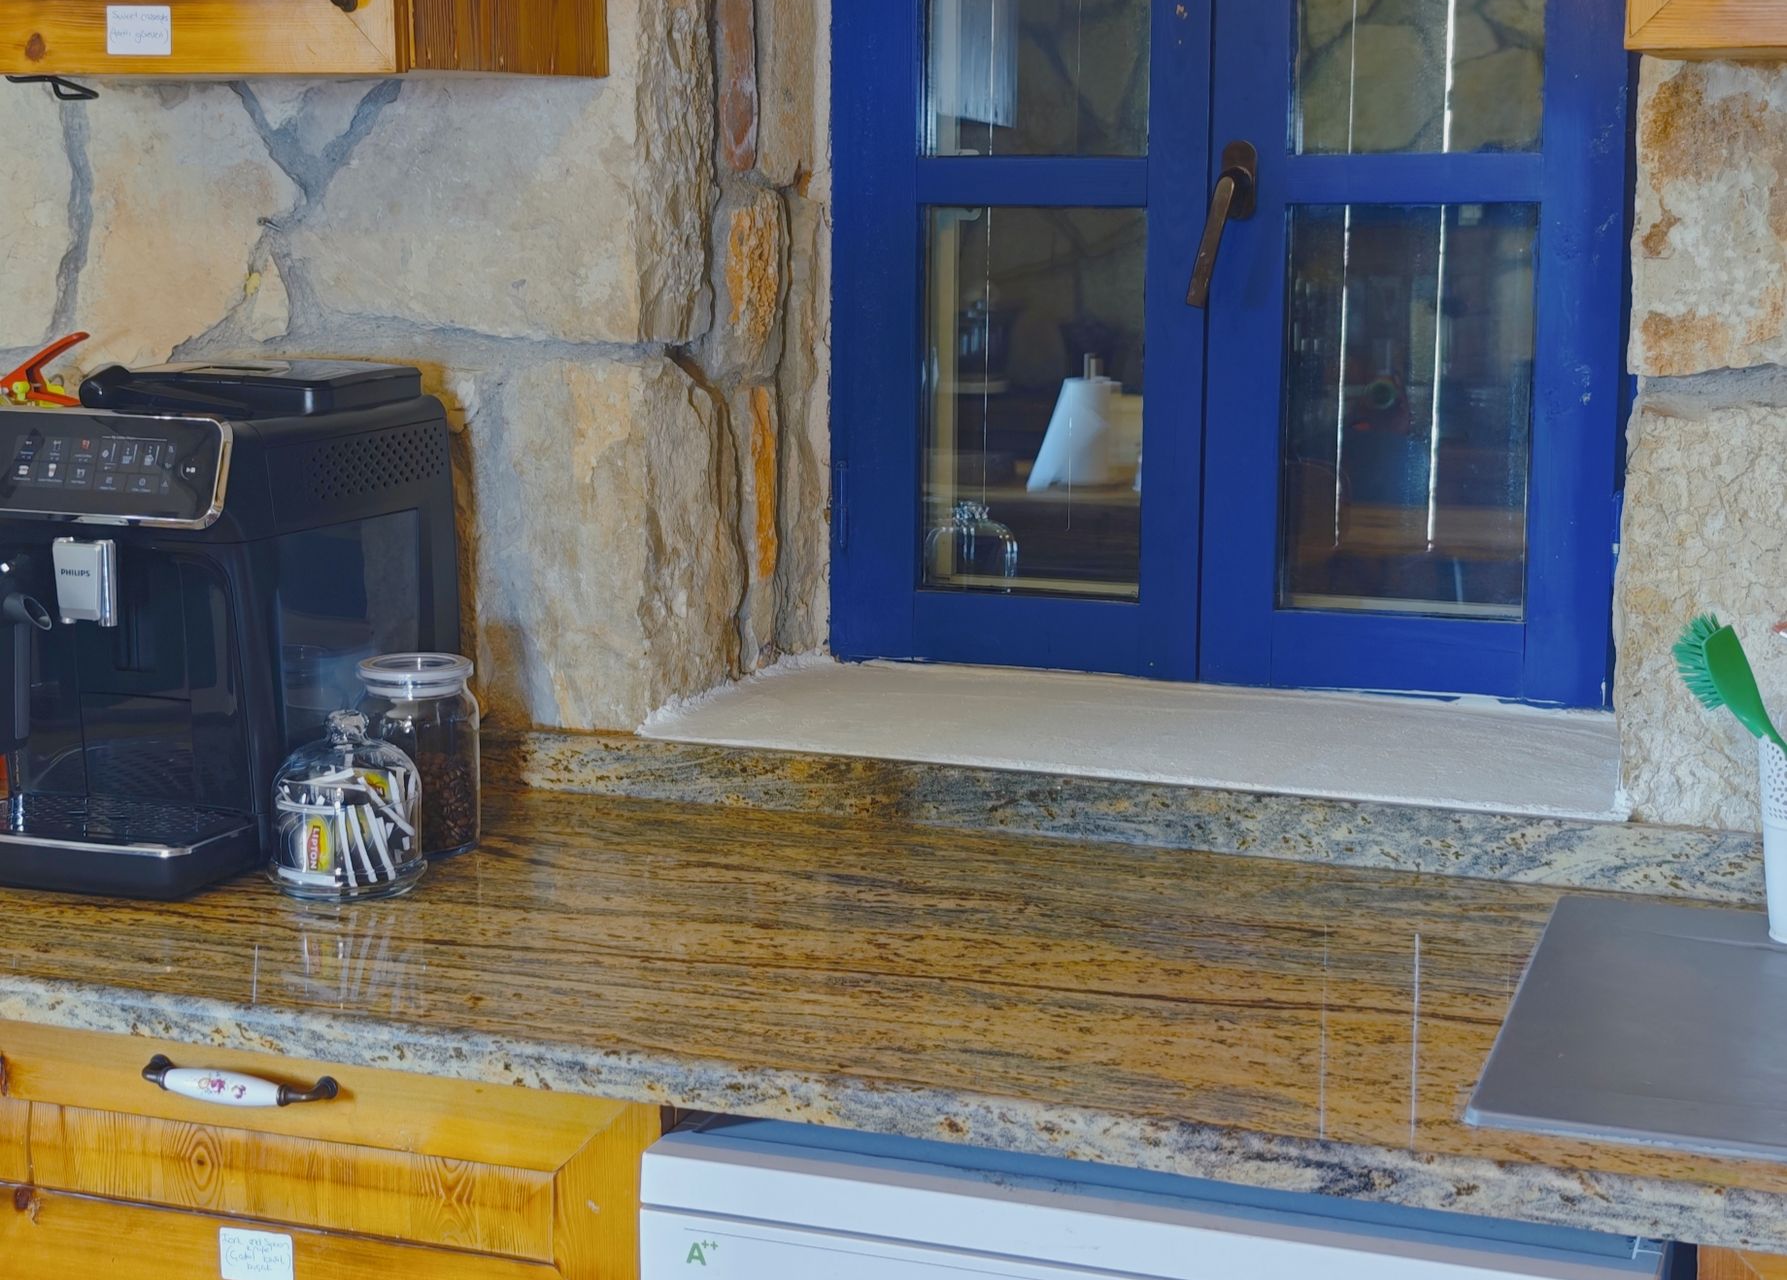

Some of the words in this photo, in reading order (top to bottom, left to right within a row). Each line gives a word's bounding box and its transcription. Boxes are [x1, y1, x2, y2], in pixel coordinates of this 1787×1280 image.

[60, 568, 91, 577] PHILIPS
[310, 825, 321, 870] LIPTON
[686, 1239, 718, 1266] A++
